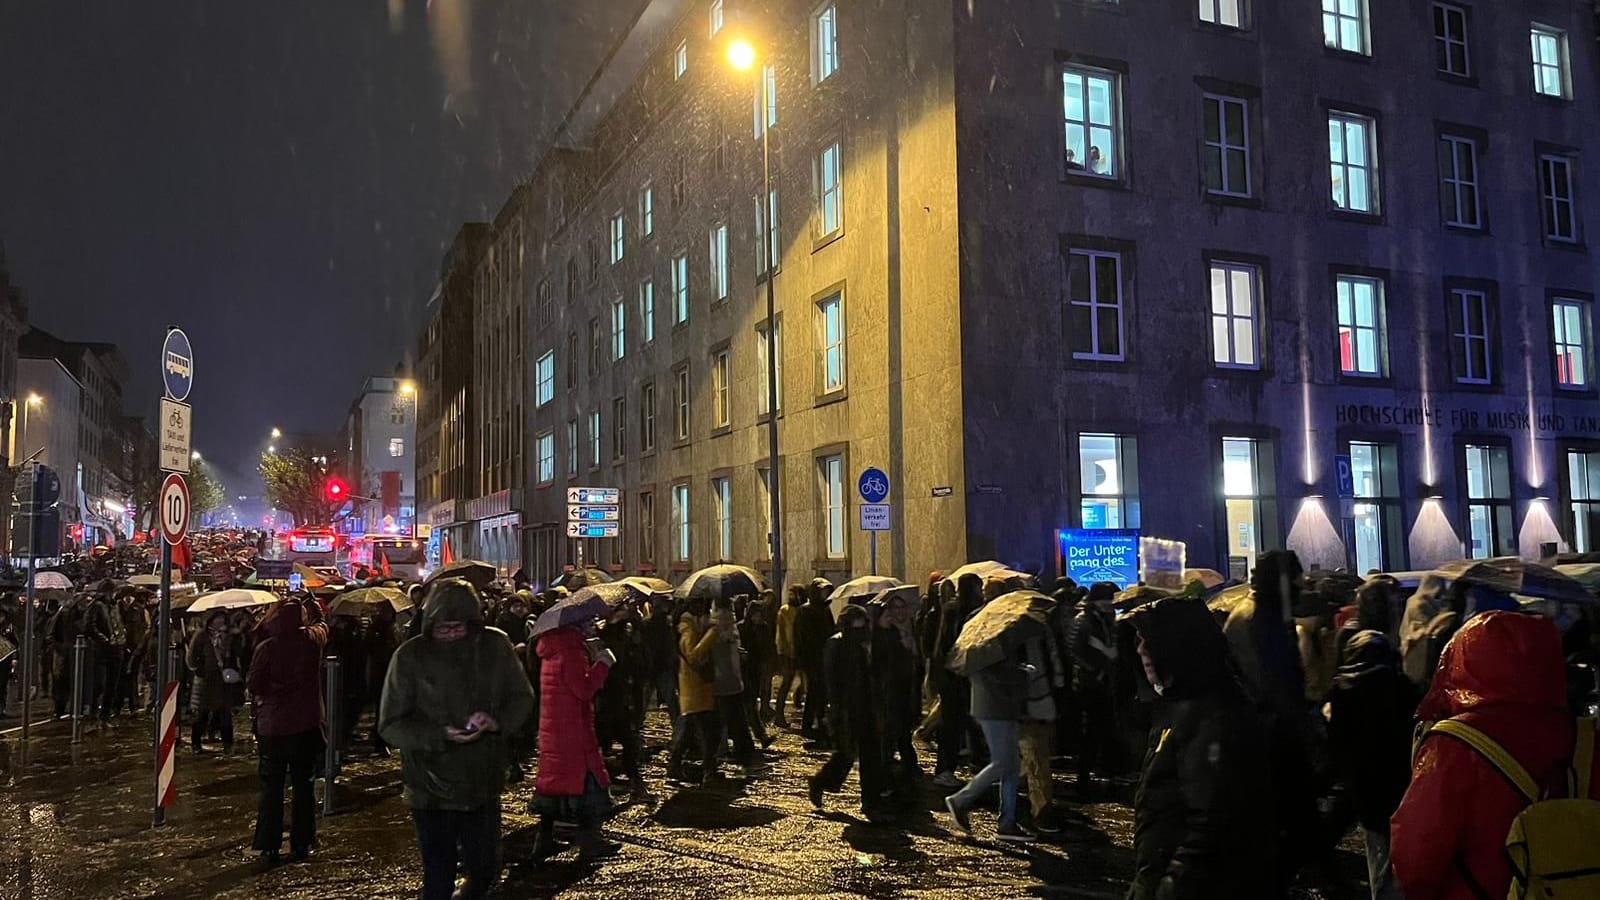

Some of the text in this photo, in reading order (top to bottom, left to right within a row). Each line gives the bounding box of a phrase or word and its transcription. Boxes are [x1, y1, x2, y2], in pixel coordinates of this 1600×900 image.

[1336, 404, 1443, 427] HOCHSCHULE
[1452, 407, 1479, 428] FÜR
[1487, 410, 1531, 432] MUSIK
[1538, 412, 1565, 432] UND
[1338, 460, 1350, 490] P
[168, 494, 181, 526] 10
[1069, 544, 1132, 558] Der Unter-
[1069, 558, 1100, 571] gang
